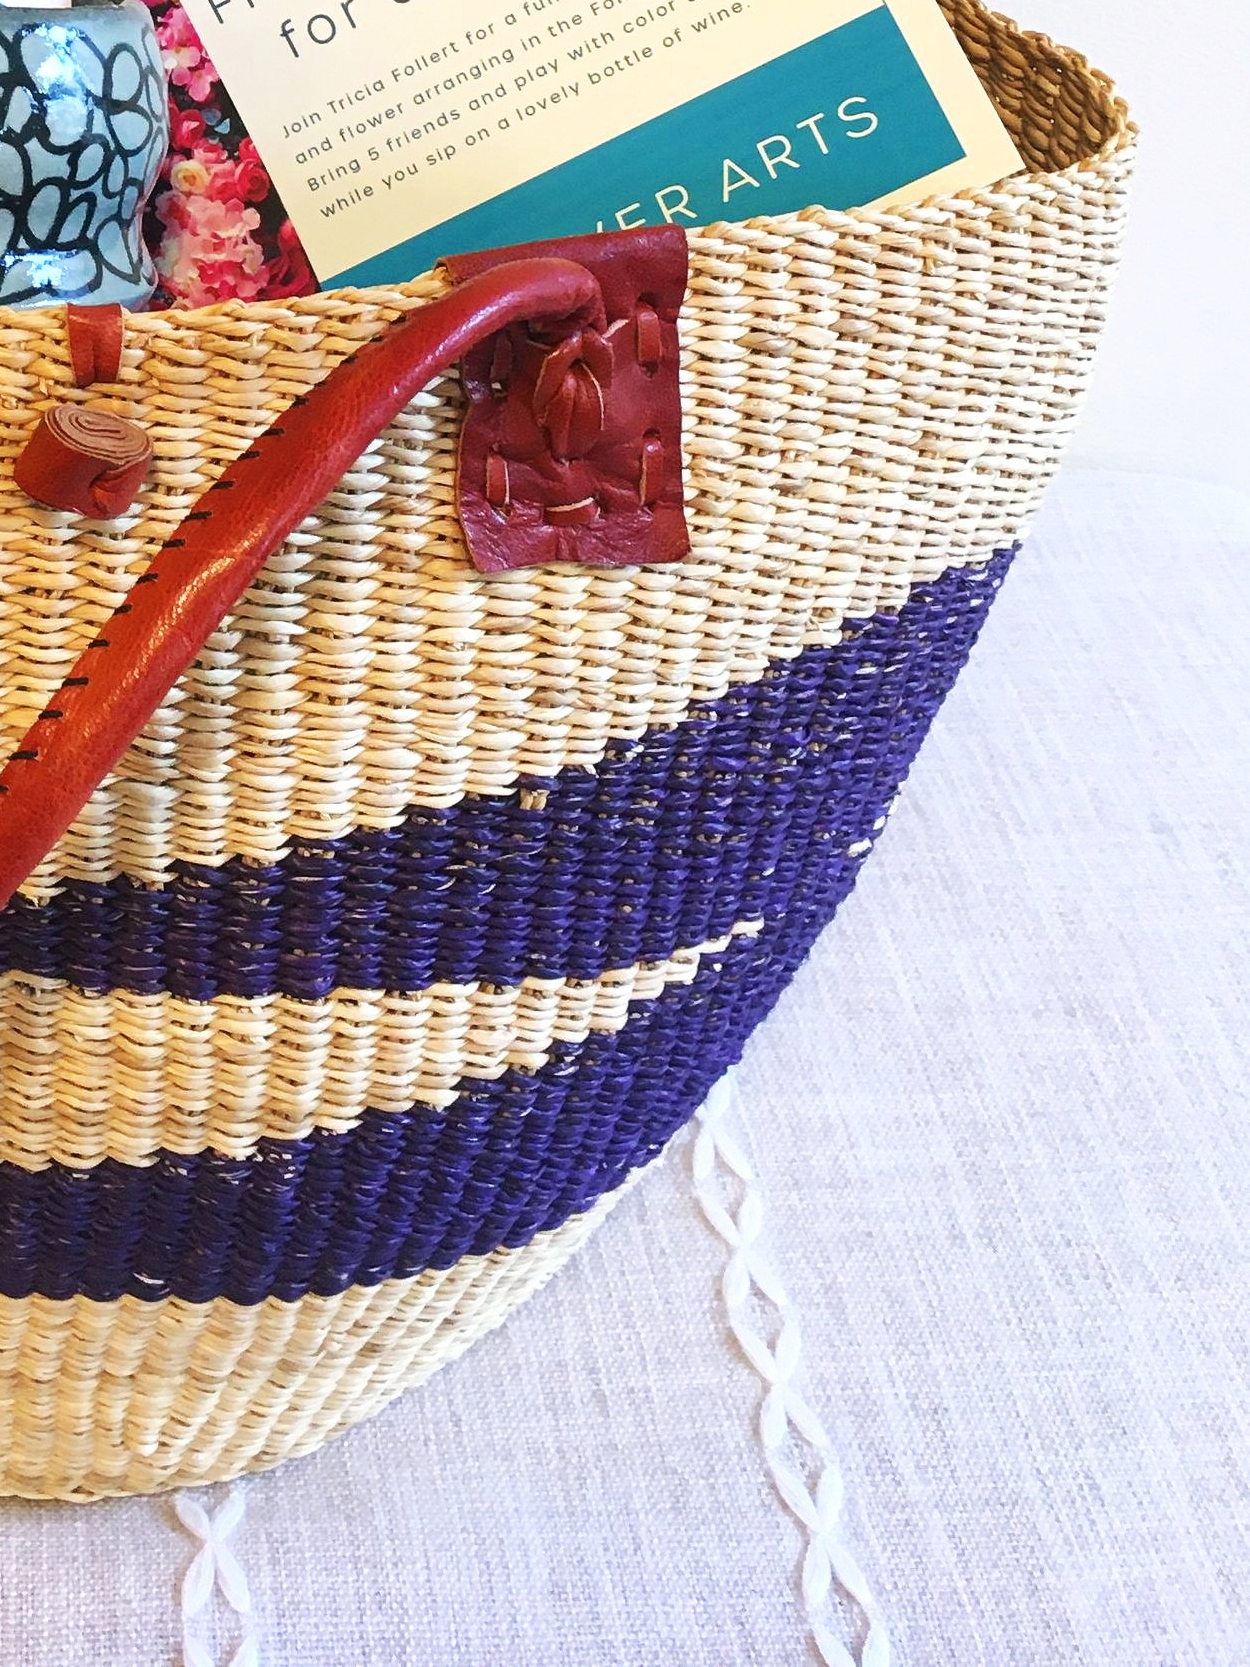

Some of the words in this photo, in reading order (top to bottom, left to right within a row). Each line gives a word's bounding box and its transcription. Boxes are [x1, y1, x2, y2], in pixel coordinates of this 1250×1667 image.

[282, 112, 322, 139] Join
[326, 79, 386, 114] Tricia
[390, 41, 460, 83] Follert
[465, 22, 495, 46] for
[504, 13, 518, 26] a
[295, 136, 333, 165] and
[338, 102, 403, 143] flower
[412, 48, 515, 106] arranging
[520, 35, 542, 52] in
[547, 13, 583, 38] the
[306, 158, 362, 192] Bring
[367, 146, 380, 162] 5
[385, 109, 461, 153] friends
[468, 82, 508, 111] and
[513, 58, 558, 92] play
[566, 32, 615, 62] with
[622, 0, 676, 34] color
[319, 185, 375, 218] while
[381, 162, 419, 191] you
[425, 144, 457, 166] sip
[464, 127, 491, 147] on
[497, 117, 511, 131] a
[515, 81, 580, 121] lovely
[586, 46, 654, 86] bottle
[662, 27, 682, 48] of
[690, 2, 750, 33] wine.
[596, 184, 699, 234] ER
[722, 95, 880, 204] ARTS
